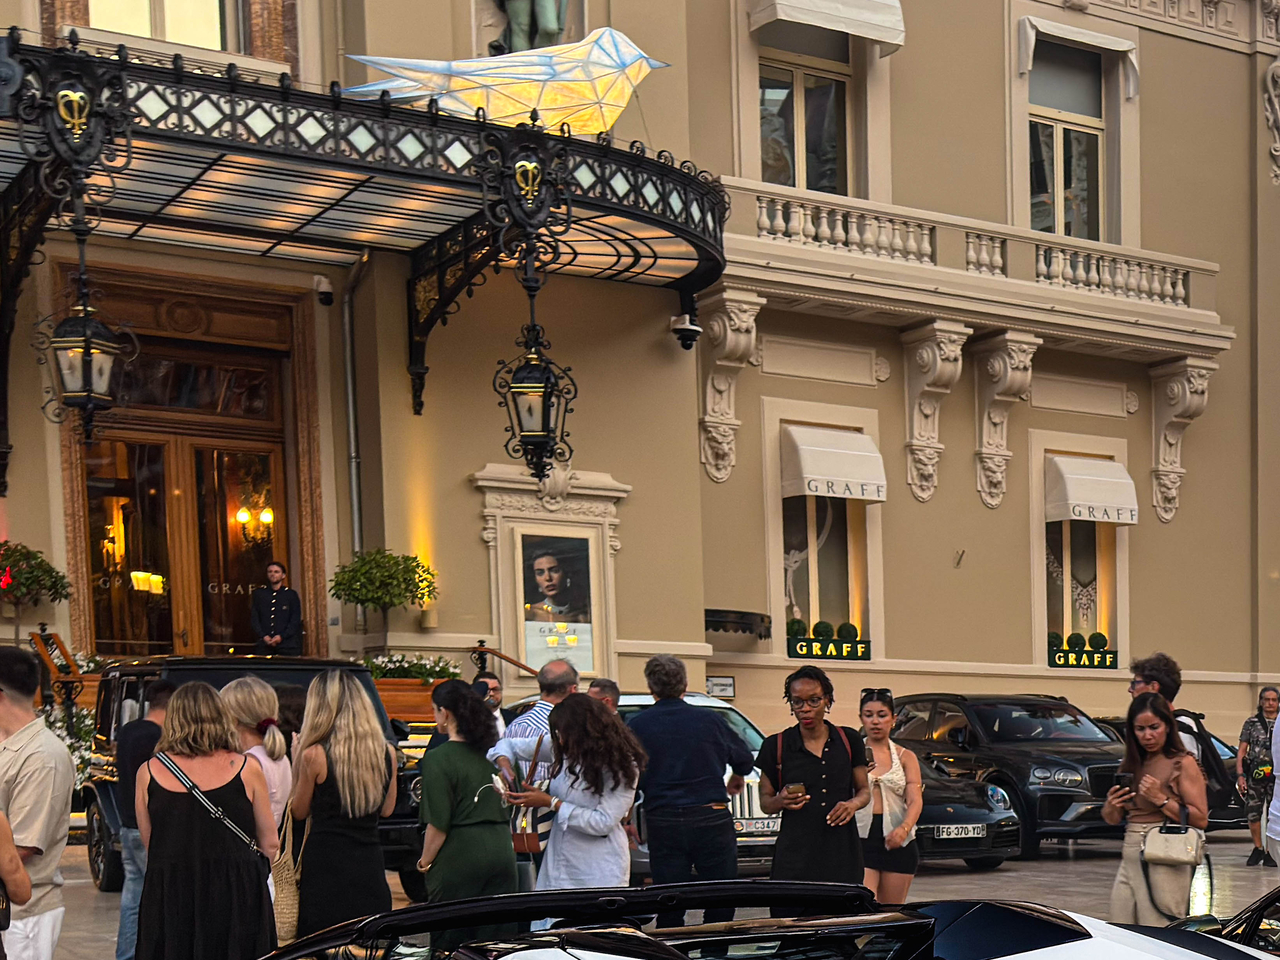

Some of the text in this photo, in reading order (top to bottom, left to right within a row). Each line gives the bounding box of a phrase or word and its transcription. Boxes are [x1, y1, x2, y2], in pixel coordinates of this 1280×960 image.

[807, 479, 884, 498] GRAFF
[1072, 504, 1137, 521] GRAFF
[796, 641, 866, 657] GRAFF
[1055, 652, 1114, 666] GRAFF
